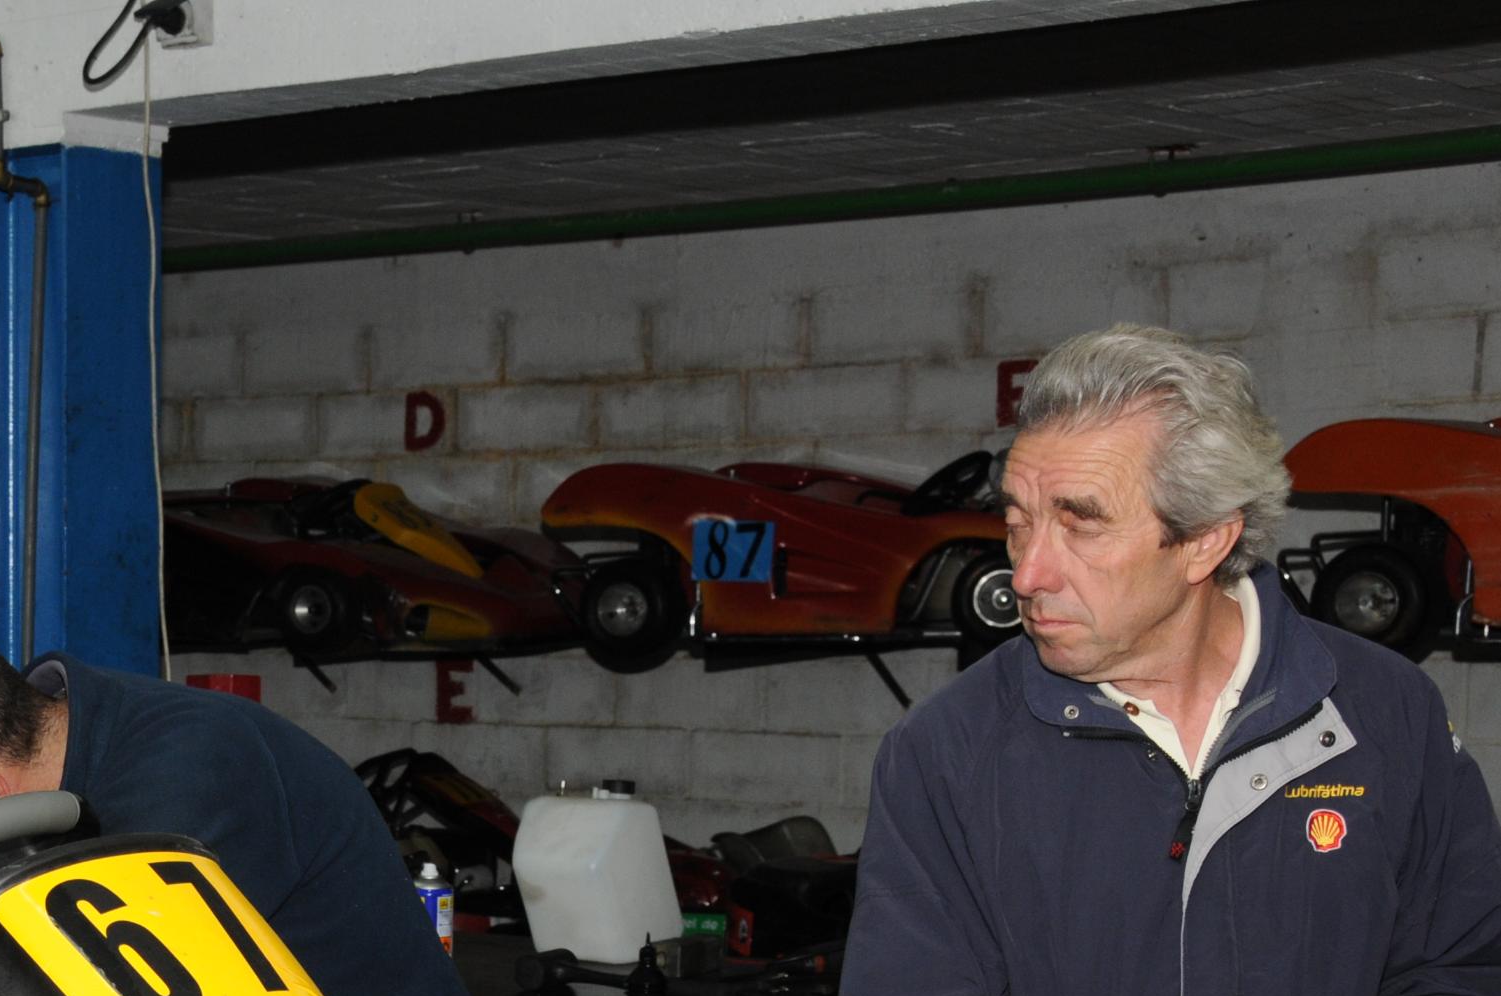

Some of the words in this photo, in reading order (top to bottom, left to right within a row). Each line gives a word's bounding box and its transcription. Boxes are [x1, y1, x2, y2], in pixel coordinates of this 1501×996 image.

[405, 391, 446, 451] D
[705, 519, 765, 579] 87
[436, 657, 475, 724] E
[1284, 783, 1366, 799] Lubrifátima
